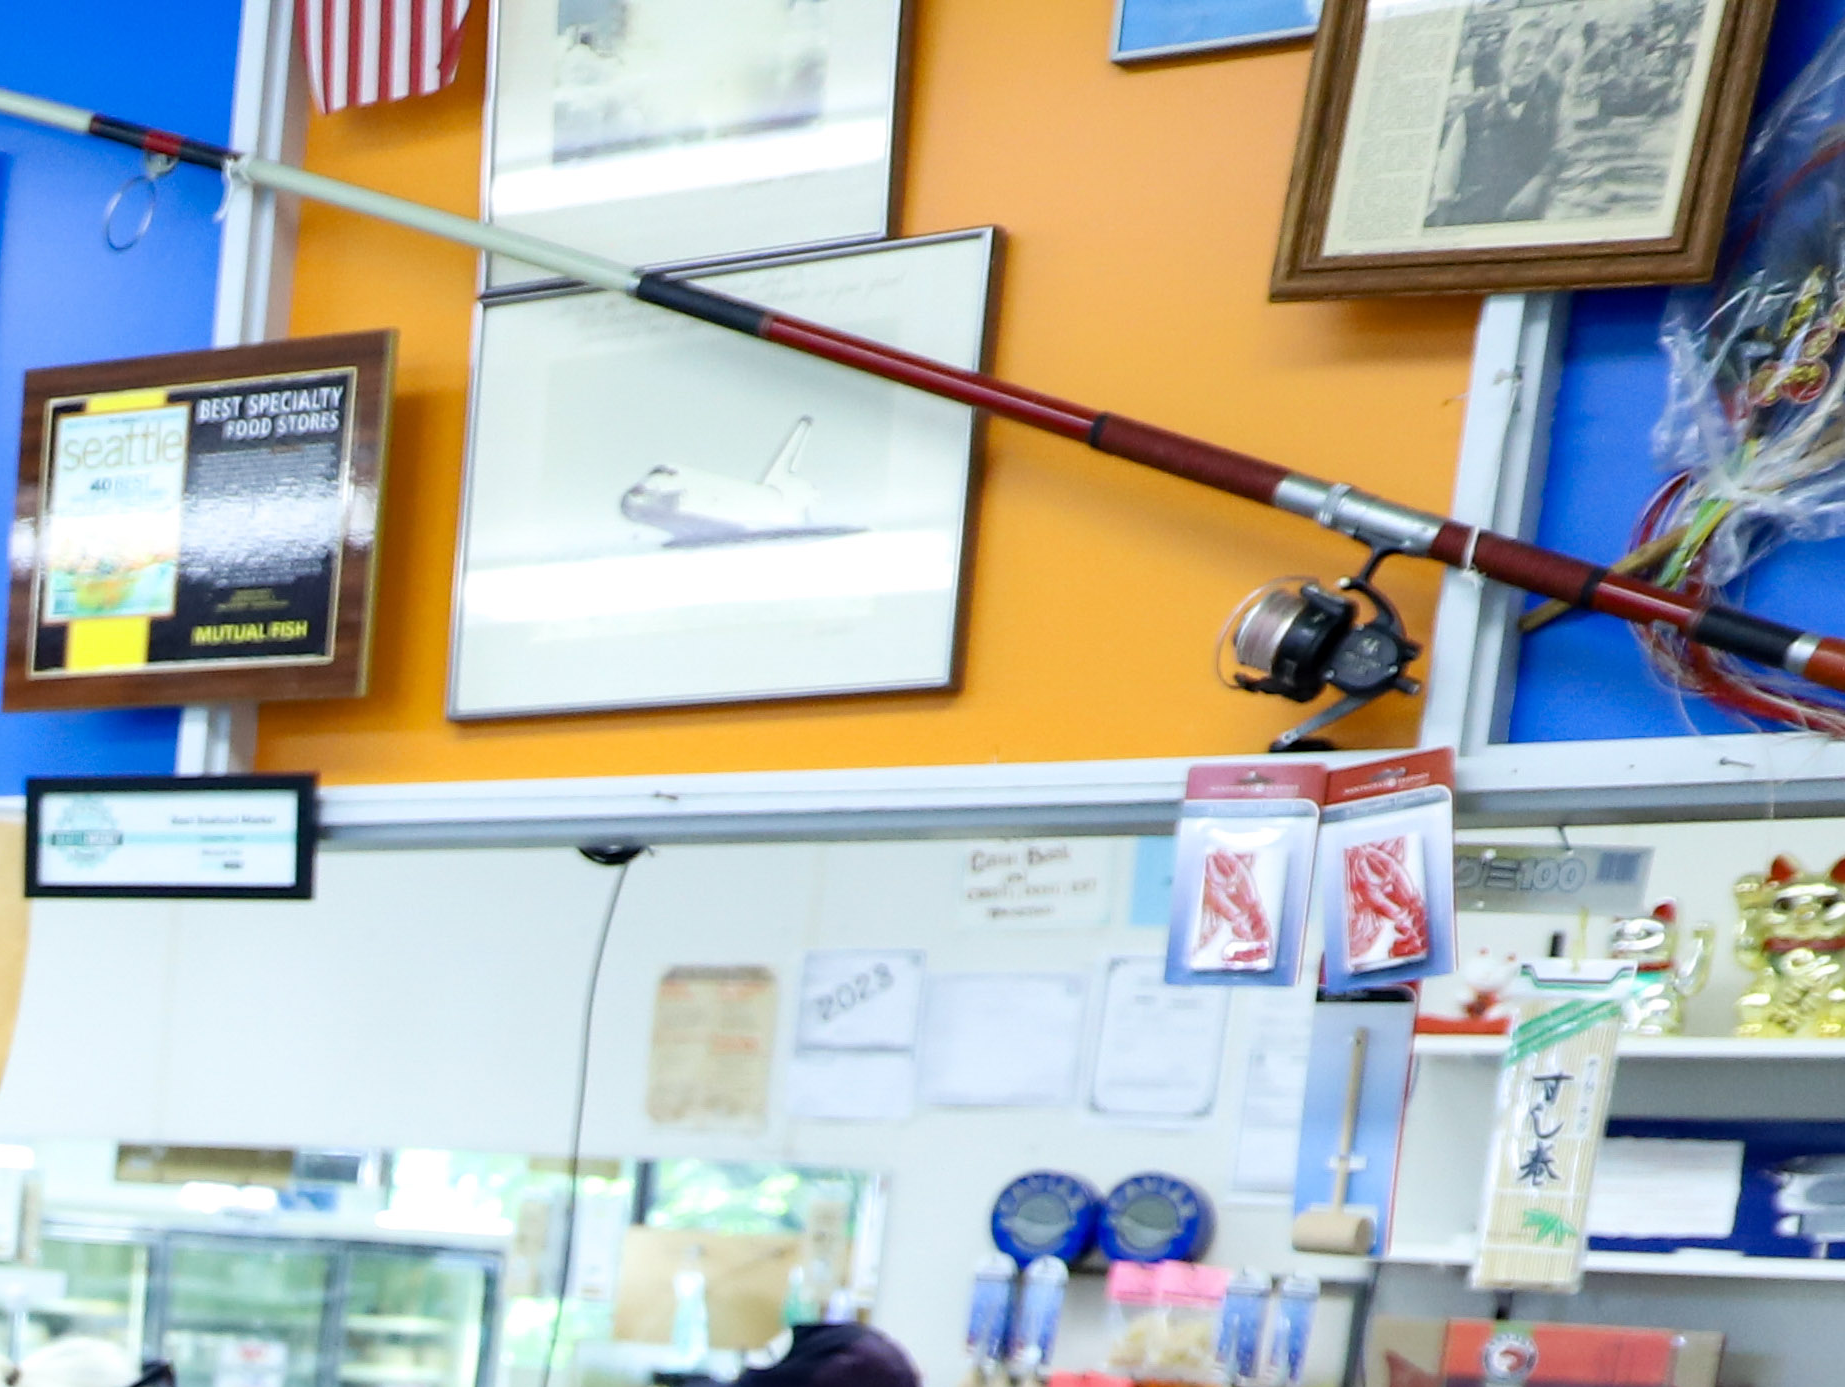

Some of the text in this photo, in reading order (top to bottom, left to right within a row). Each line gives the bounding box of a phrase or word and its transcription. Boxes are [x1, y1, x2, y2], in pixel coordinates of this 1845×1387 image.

[196, 386, 344, 425] BEST SPECIALTY
[223, 410, 340, 441] FOOD STORES
[62, 421, 184, 472] seattle
[191, 619, 309, 648] MUTUAL FISH
[814, 962, 895, 1022] 2023
[1517, 1072, 1575, 1187] すし巻
